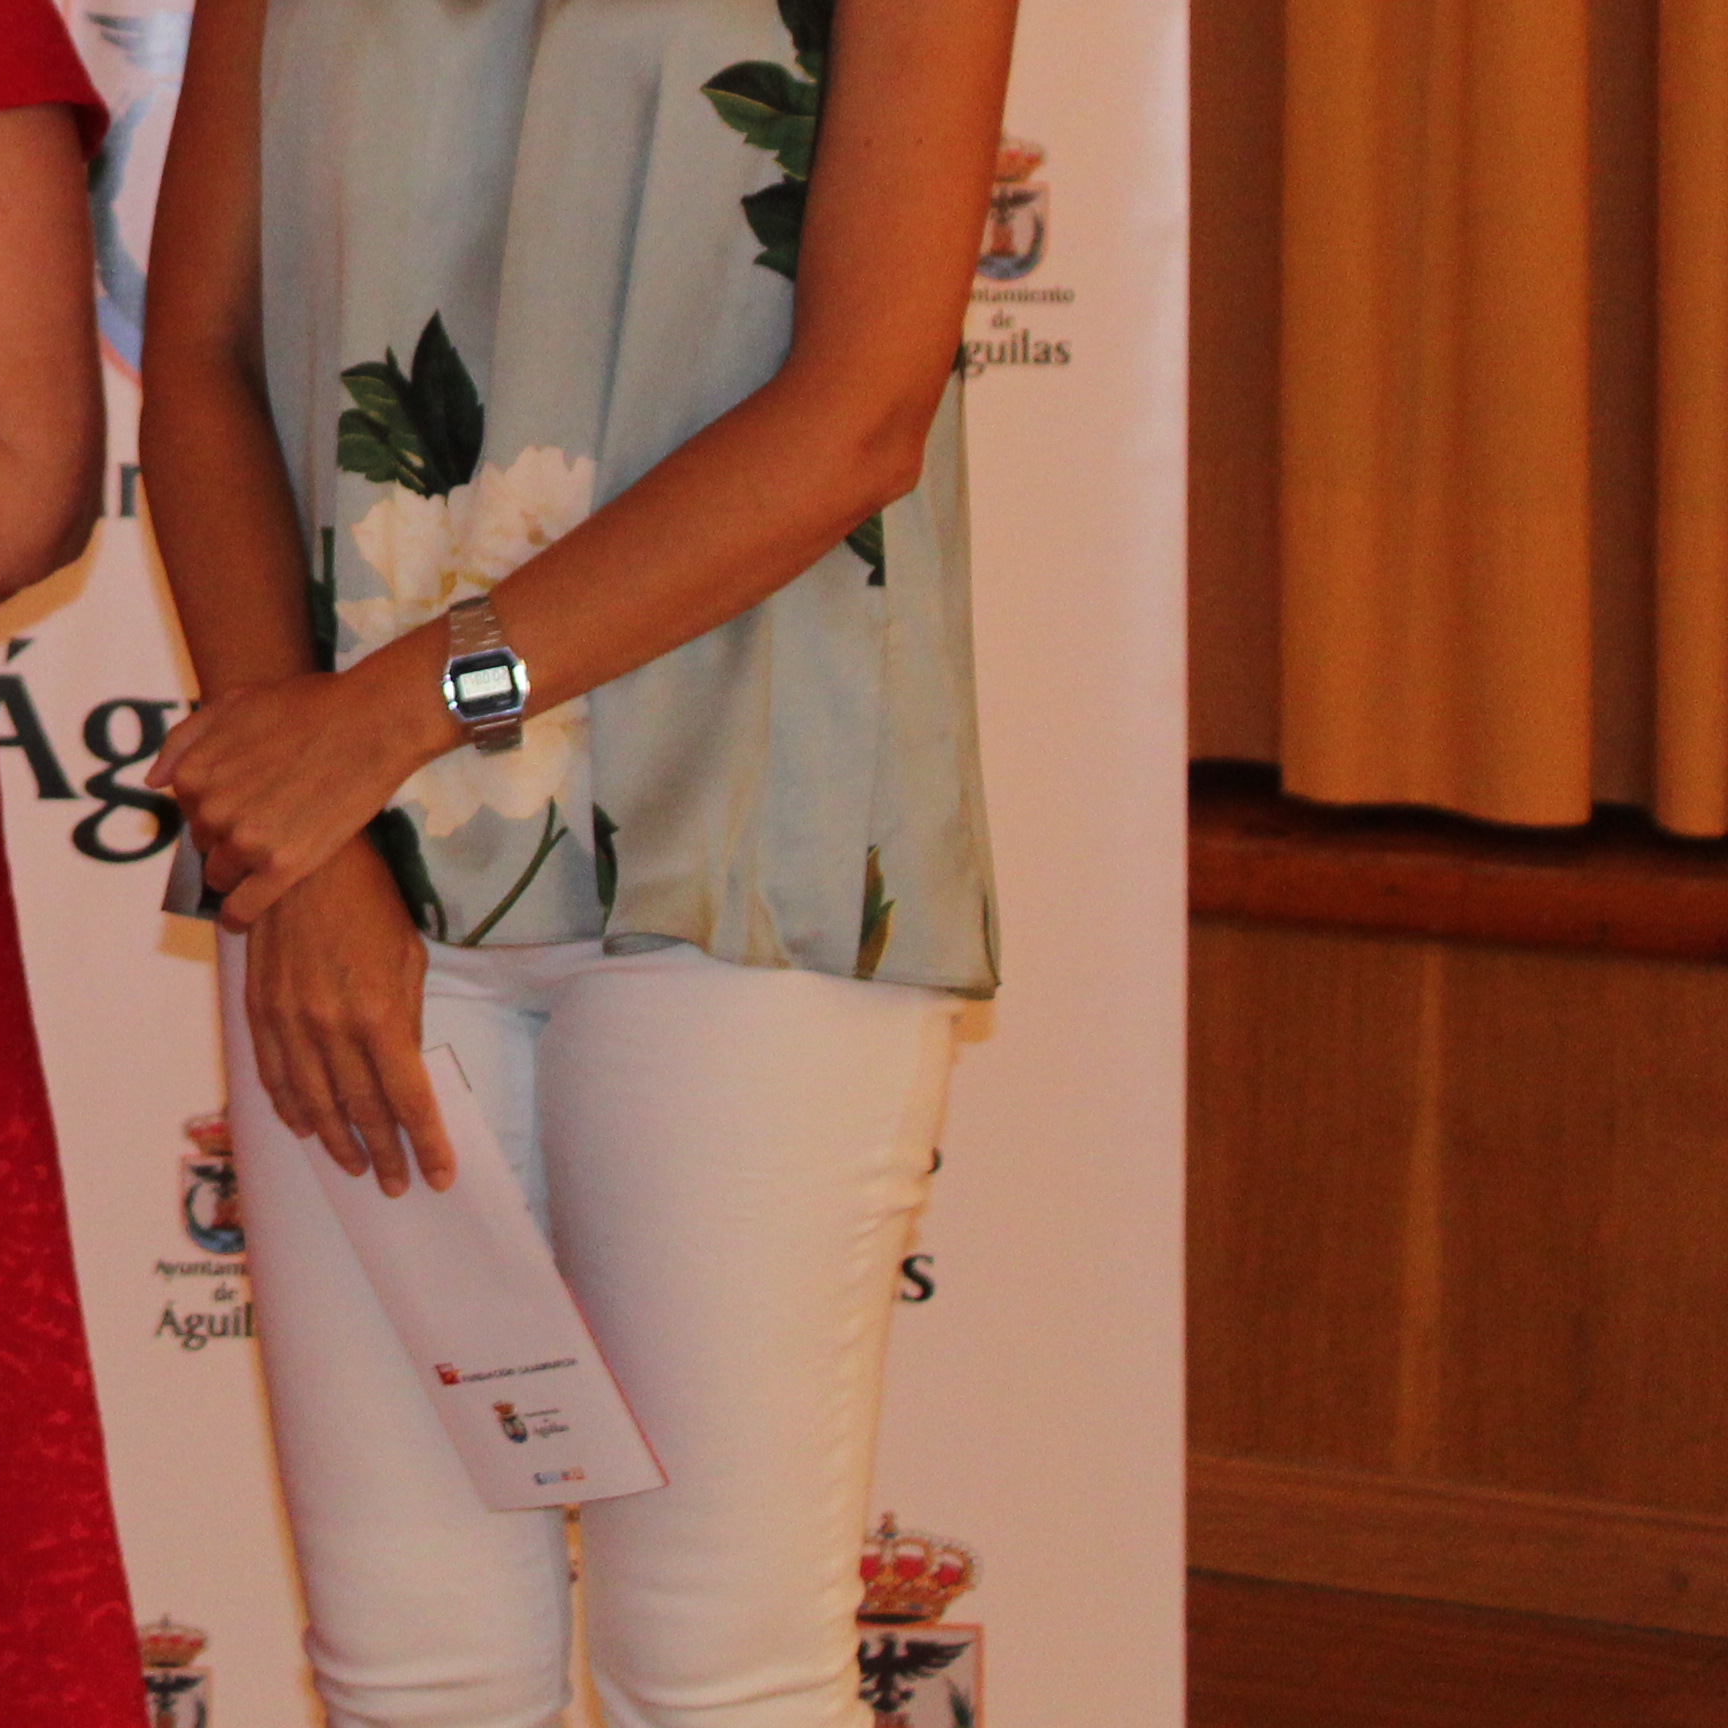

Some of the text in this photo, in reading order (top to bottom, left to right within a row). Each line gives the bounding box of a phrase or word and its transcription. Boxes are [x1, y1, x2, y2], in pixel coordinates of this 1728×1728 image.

[992, 308, 1013, 328] de
[963, 329, 1072, 378] guilas
[155, 1259, 246, 1281] Ayuntam
[213, 1281, 238, 1301] de
[155, 1301, 253, 1351] Águil
